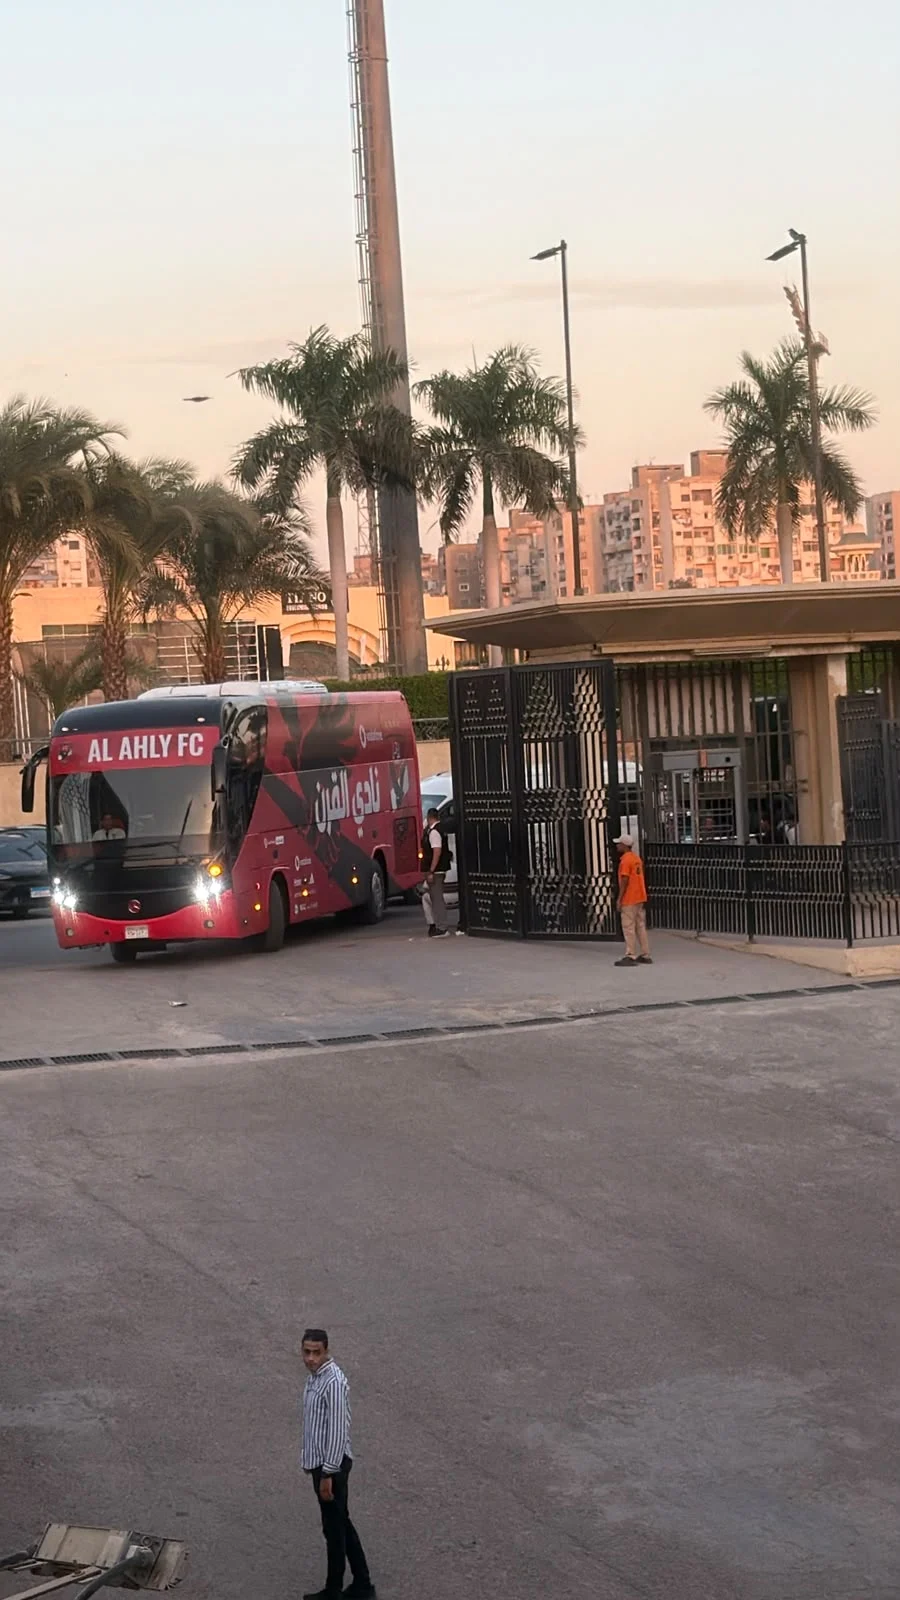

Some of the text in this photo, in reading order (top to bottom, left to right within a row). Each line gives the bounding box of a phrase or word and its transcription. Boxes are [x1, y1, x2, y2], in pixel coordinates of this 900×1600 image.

[88, 732, 204, 763] AL AHLY FC
[315, 765, 381, 839] نادي القرن
